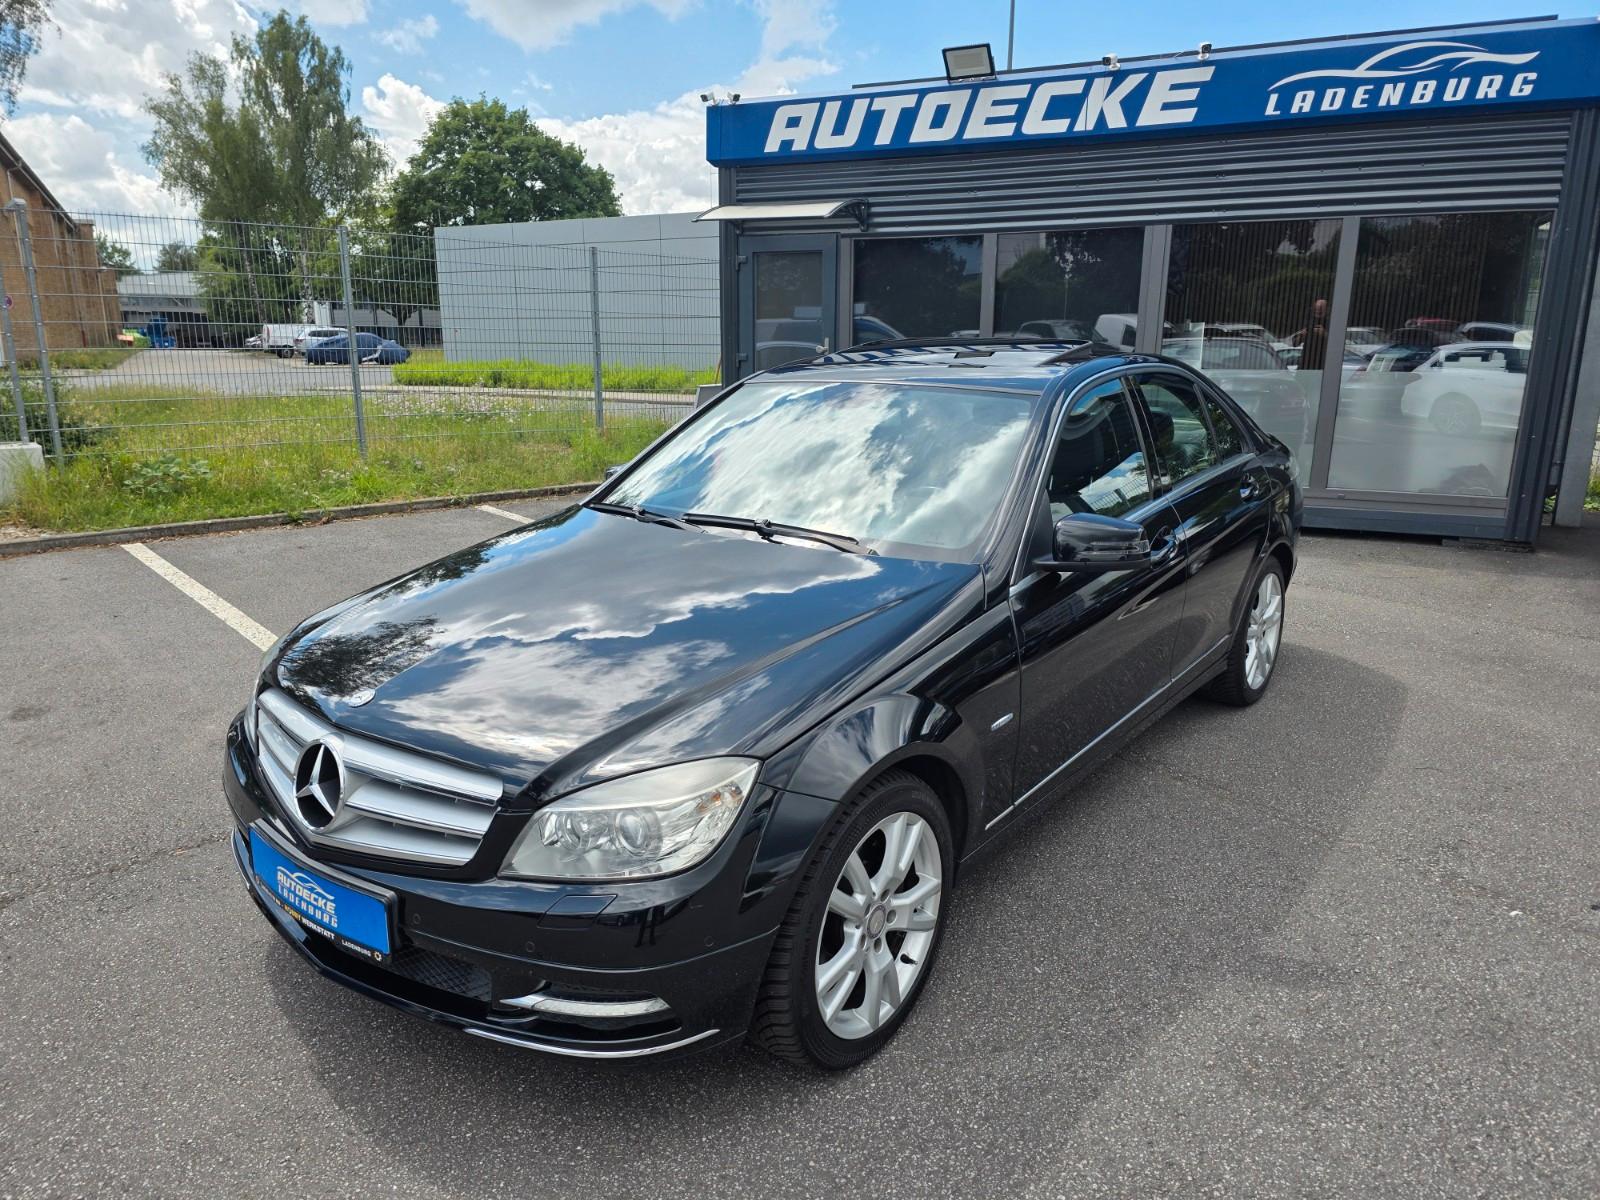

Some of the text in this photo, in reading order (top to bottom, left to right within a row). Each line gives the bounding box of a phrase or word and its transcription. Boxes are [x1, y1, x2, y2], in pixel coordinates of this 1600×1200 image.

[764, 65, 1216, 153] AUTOECKE
[1264, 72, 1538, 116] LADENBURG
[277, 871, 336, 914] AUTOECKE
[278, 884, 338, 928] LADENBURG
